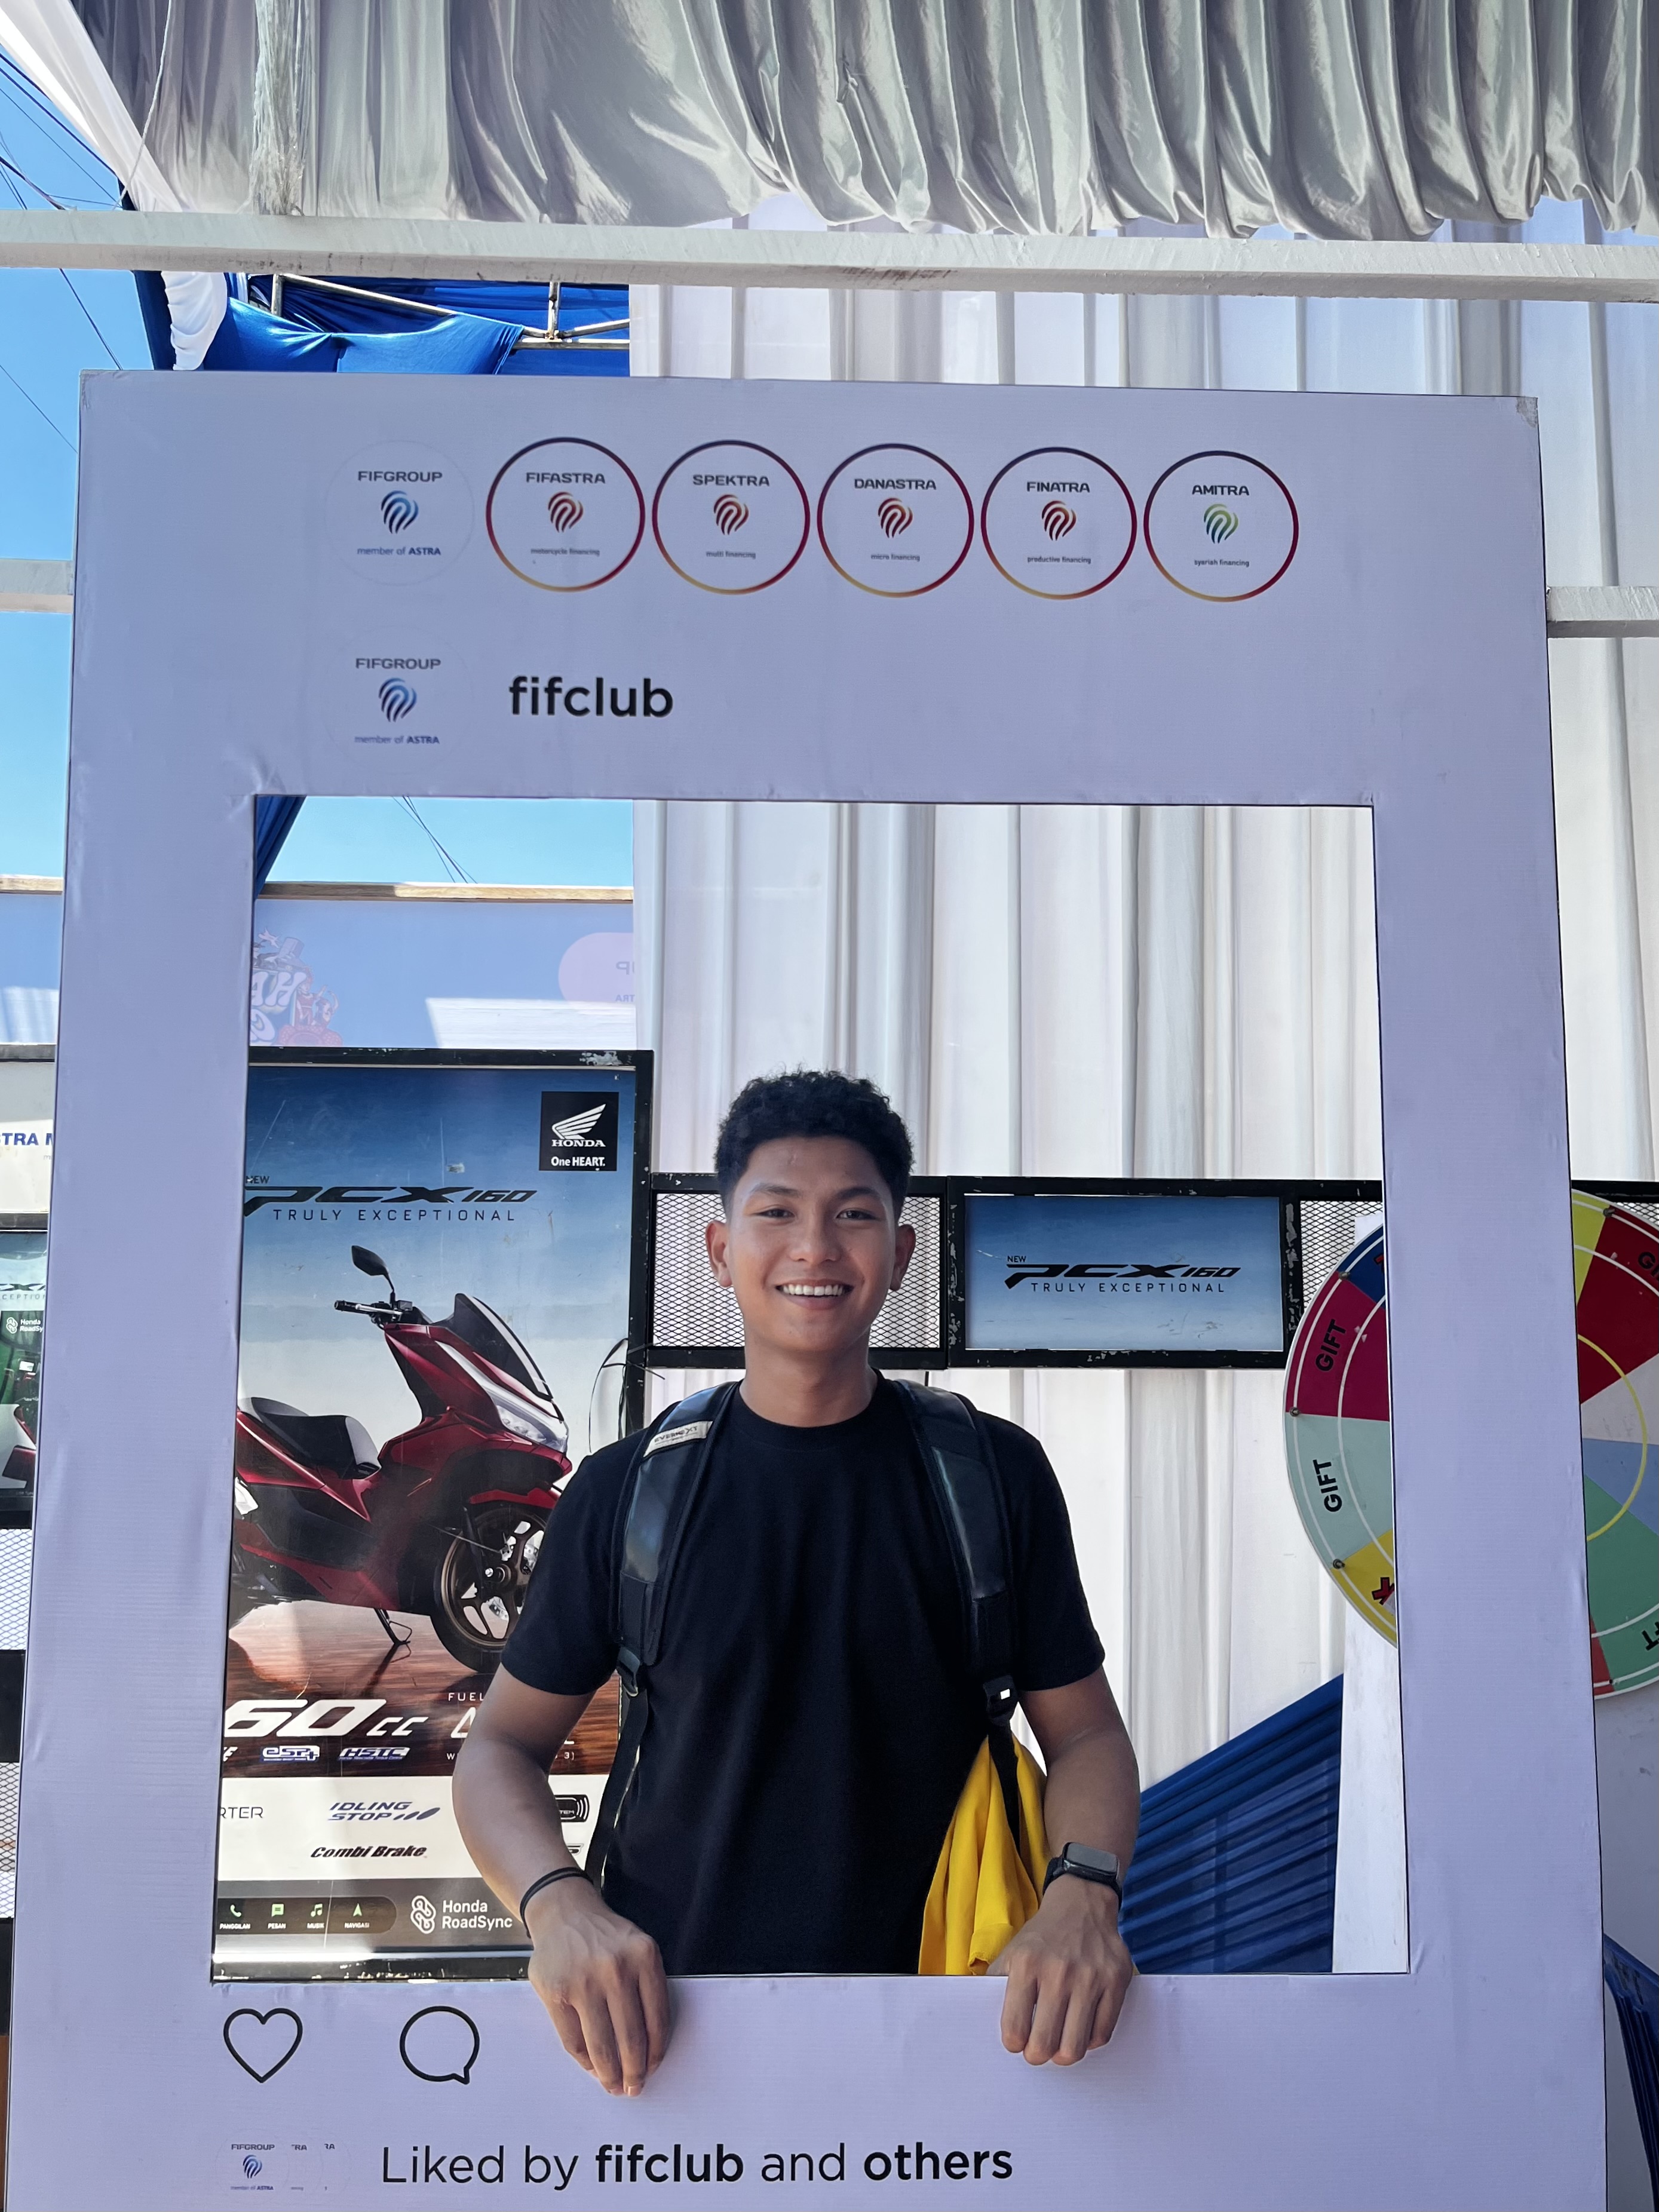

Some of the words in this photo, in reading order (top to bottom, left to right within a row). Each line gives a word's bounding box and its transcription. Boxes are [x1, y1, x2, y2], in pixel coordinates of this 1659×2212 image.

[358, 471, 443, 483] FIFGROUP
[526, 472, 606, 484] FIFASTRA
[692, 474, 770, 487] SPEKTRA
[854, 478, 937, 490] DANASTRA
[1026, 481, 1090, 493] FINATRA
[1192, 484, 1250, 496] AMITRA
[357, 547, 394, 556] member
[397, 547, 406, 556] of
[408, 547, 441, 556] ASTRA
[569, 548, 600, 557] financing
[725, 551, 756, 560] financing
[891, 553, 921, 562] financing
[1027, 556, 1060, 564] productive
[1062, 556, 1091, 565] financing
[1194, 559, 1218, 567] syariah
[1219, 559, 1250, 568] financing
[355, 658, 441, 670] FIFGROUP
[508, 675, 673, 718] fifclub
[354, 735, 392, 744] member
[394, 735, 404, 744] of
[406, 735, 440, 744] ASTRA
[0, 1133, 39, 1146] TRA
[551, 1156, 571, 1166] One
[572, 1156, 606, 1167] HEART.
[272, 1210, 342, 1221] TRULY
[358, 1210, 514, 1221] EXCEPTIONAL
[1031, 1283, 1087, 1293] TRULY
[1099, 1283, 1225, 1293] EXCEPTIONAL
[1315, 1318, 1347, 1372] GIFT
[1313, 1459, 1342, 1512] GIFT
[448, 1692, 484, 1701] FUEL
[329, 1802, 413, 1811] IDLING
[328, 1812, 392, 1821] STOP
[310, 1846, 373, 1858] Combi
[370, 1845, 427, 1858] Brake
[442, 1900, 488, 1913] Honda
[441, 1915, 513, 1931] RoadSync
[382, 2144, 504, 2183] Liked
[524, 2146, 579, 2191] by
[596, 2143, 744, 2183] fifclub
[760, 2143, 845, 2182] and
[863, 2142, 1013, 2180] others
